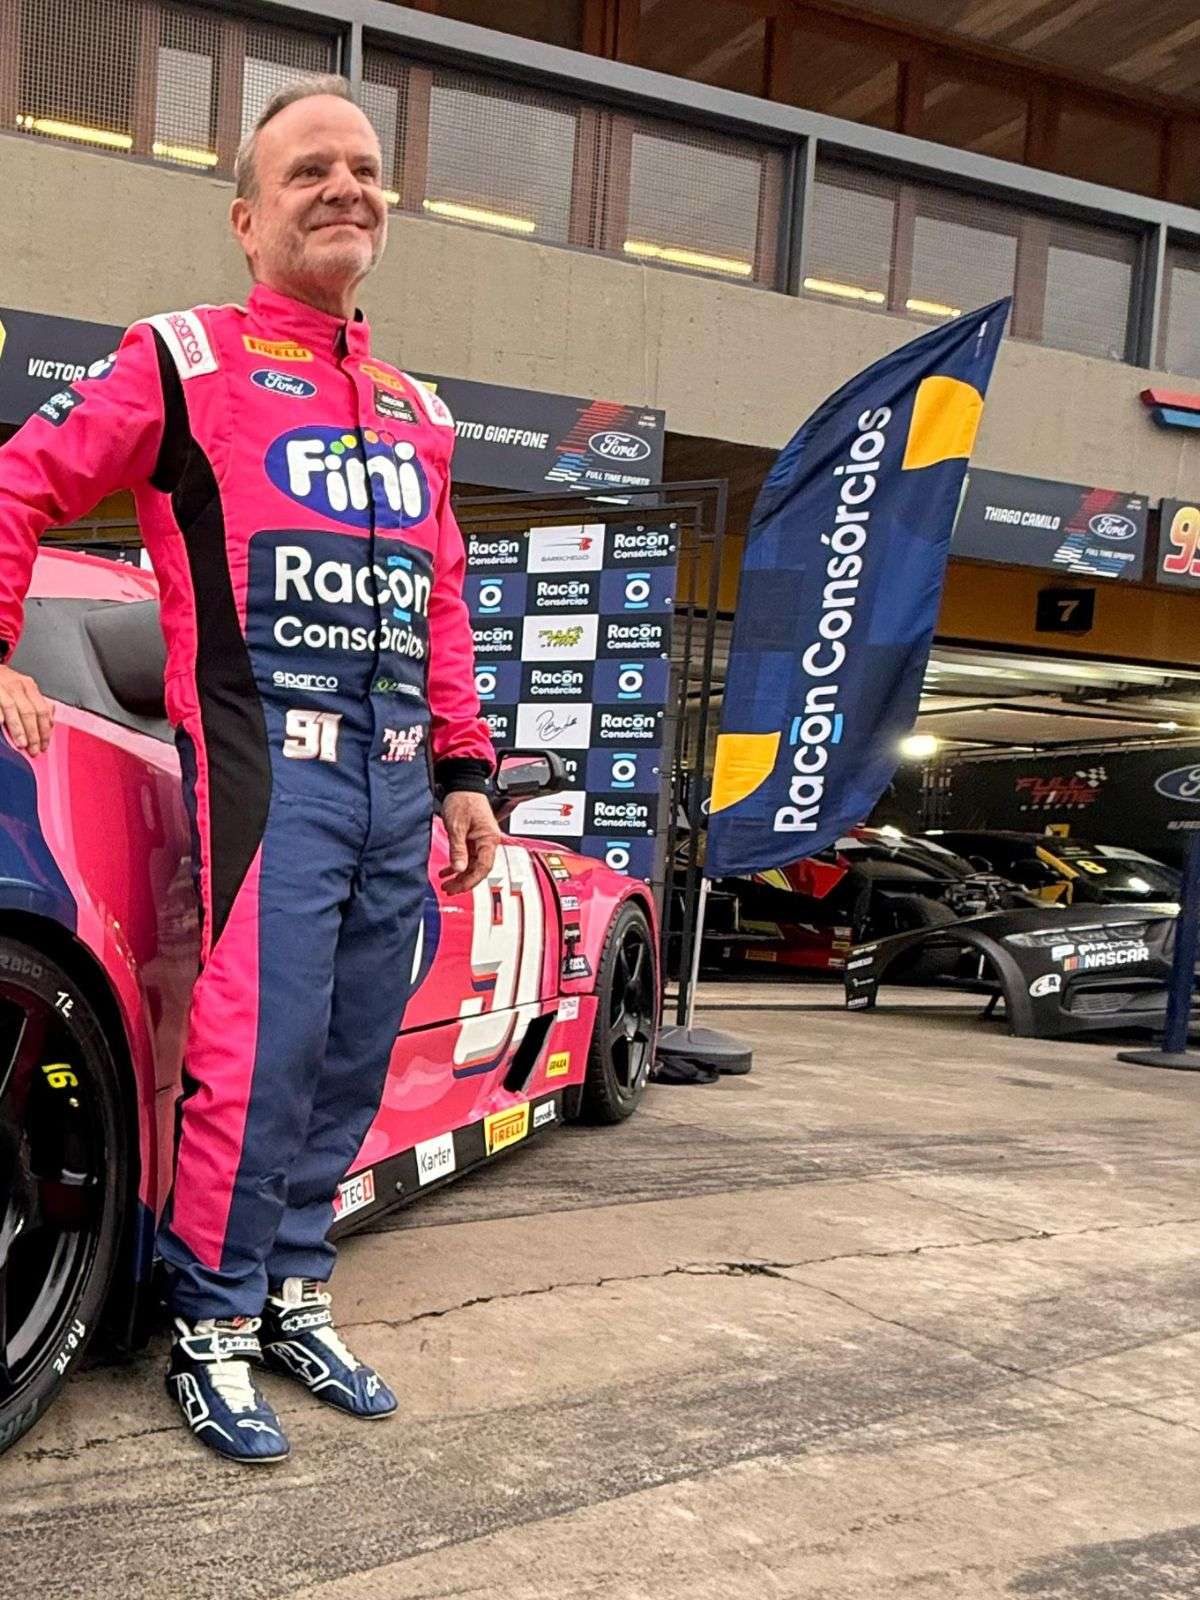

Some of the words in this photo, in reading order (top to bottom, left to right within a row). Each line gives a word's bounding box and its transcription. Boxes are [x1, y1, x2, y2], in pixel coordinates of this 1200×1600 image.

[27, 358, 86, 382] VICTOR
[264, 372, 304, 395] Ford
[455, 421, 484, 440] TITO
[484, 425, 549, 449] GIAFFONE
[600, 434, 640, 458] Ford
[286, 438, 422, 518] Fini
[984, 506, 1022, 525] THIAGO
[1021, 512, 1061, 530] CAMILO
[1097, 518, 1128, 537] Ford
[469, 541, 520, 556] Racon
[614, 533, 669, 549] Racon
[802, 406, 892, 677] Consórcios
[1163, 506, 1200, 577] 9
[274, 545, 431, 618] Racon
[537, 582, 590, 597] Racon
[1057, 600, 1079, 622] 7
[273, 616, 425, 660] Consórcios
[472, 629, 513, 643] acon
[607, 624, 662, 639] Racon
[273, 670, 338, 690] sparco
[531, 671, 583, 685] Racon
[601, 715, 655, 729] Racon
[282, 708, 343, 763] 91
[773, 684, 843, 833] Racon
[594, 803, 648, 818] Racon
[453, 846, 546, 1079] 91
[1085, 947, 1149, 968] NASCAR
[489, 1111, 525, 1154] PIRELLI
[420, 1147, 451, 1173] Karter
